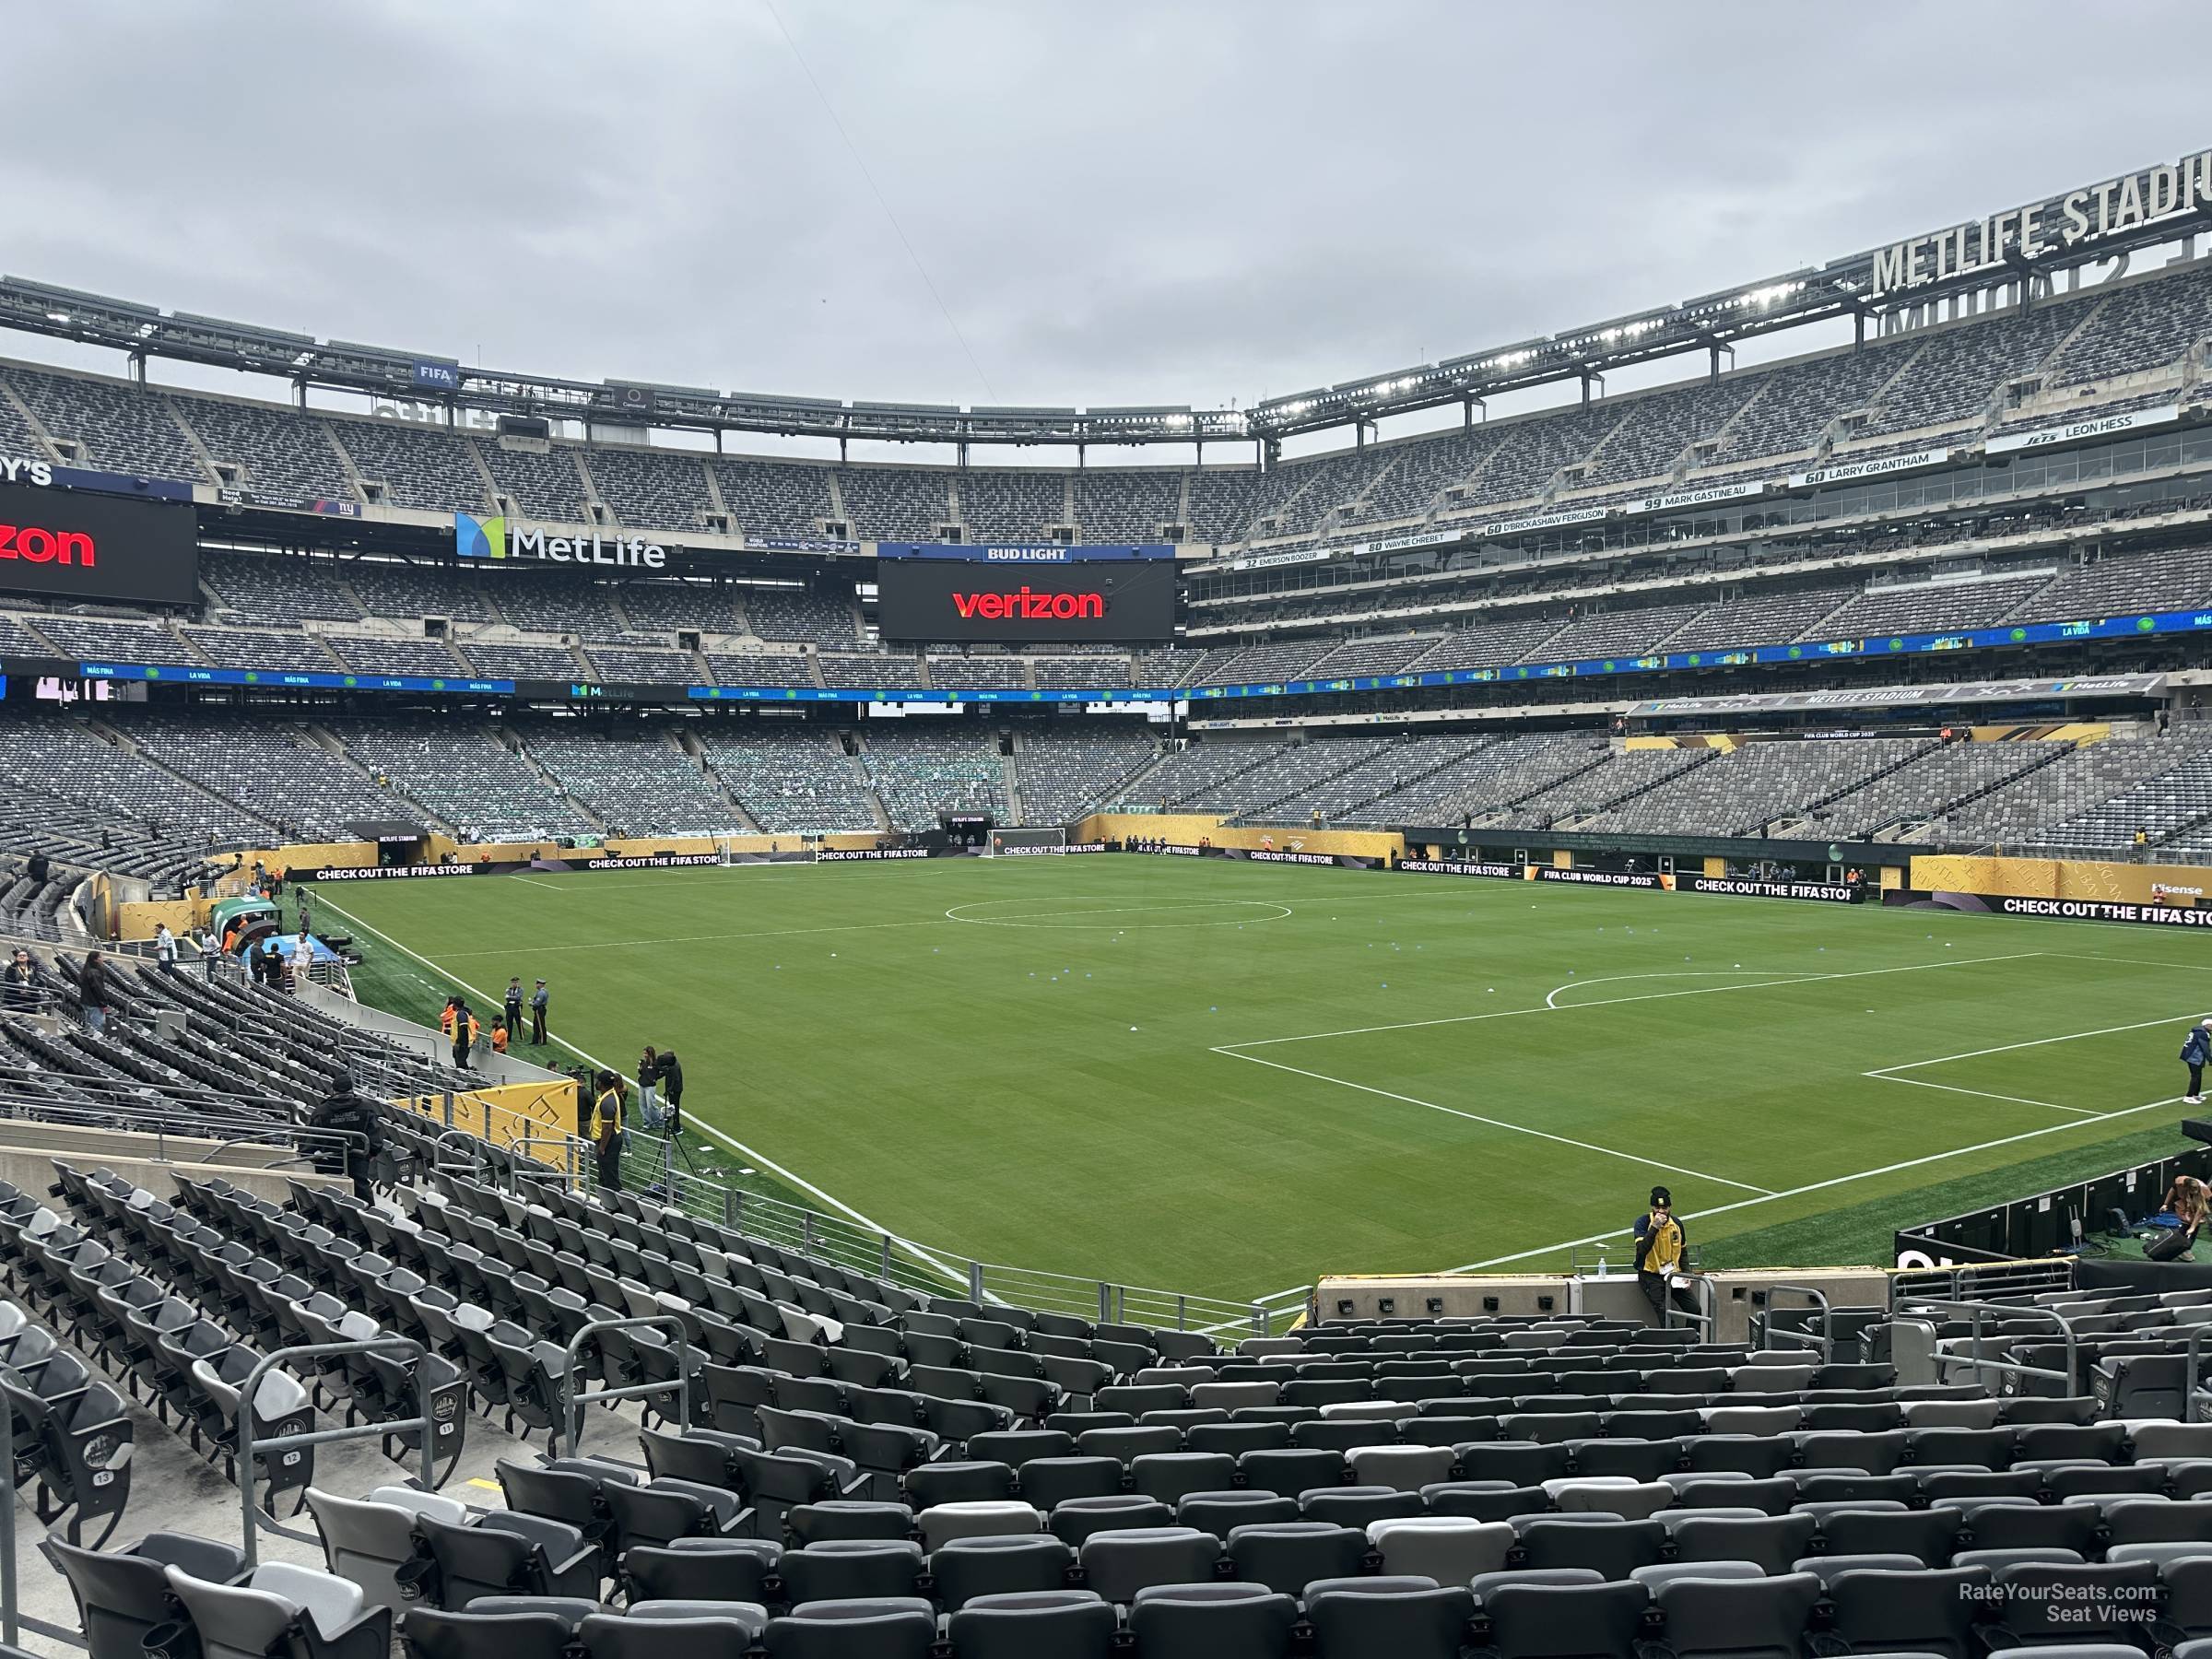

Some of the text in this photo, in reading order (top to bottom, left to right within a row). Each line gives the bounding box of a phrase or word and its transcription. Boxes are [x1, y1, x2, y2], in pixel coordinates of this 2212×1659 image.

[1873, 203, 2044, 294] METLIFE
[421, 366, 450, 381] FIFA
[2023, 416, 2132, 447] JETS LEON HESS
[1805, 453, 1929, 485] 60 LARRY GRANTHAM
[1645, 486, 1746, 510] 99 MARK GASTINEAU
[1487, 509, 1604, 535] 60 D'BRICKASHAW FERGUSON
[512, 526, 666, 568] MetLife
[1369, 534, 1444, 552] 80 WAYNE CHREBET
[988, 549, 1066, 560] BUD LIGHT
[1245, 552, 1317, 568] 32 EMERSON BOOZER
[953, 586, 1103, 619] verizon
[2063, 626, 2089, 636] LA VIDA
[2074, 681, 2129, 689] MetLife
[1806, 689, 1924, 704] METLIFE STADIUM
[589, 859, 624, 868] CHECK
[625, 858, 647, 867] OUT
[648, 857, 668, 866] THE
[671, 856, 692, 865] FIFA
[817, 849, 928, 860] CHECK OUT THE FIFA STORE
[1251, 852, 1271, 860] CHECK
[1298, 854, 1312, 863] FIFA
[1312, 856, 1333, 865] STORE
[317, 865, 472, 880] CHECK OUT THE FIFA STORE
[1401, 861, 1509, 876] CHECK OUT THE FIFA STORE
[1544, 871, 1560, 879] FIFA
[1561, 872, 1581, 881] CLUB
[1582, 873, 1611, 883] WORLD
[1613, 875, 1630, 884] CUP
[1695, 880, 1735, 893] CHECK
[1736, 882, 1762, 894] OUT
[1763, 884, 1788, 896] THE
[1791, 885, 1820, 897] FIFA
[2152, 883, 2202, 895] Hisense
[2004, 899, 2060, 915] CHECK
[2062, 902, 2100, 917] OUT
[2101, 905, 2137, 920] THE
[2141, 907, 2183, 923] FIFA
[443, 1425, 451, 1433] 11
[287, 1454, 297, 1462] 12
[97, 1473, 109, 1483] 13
